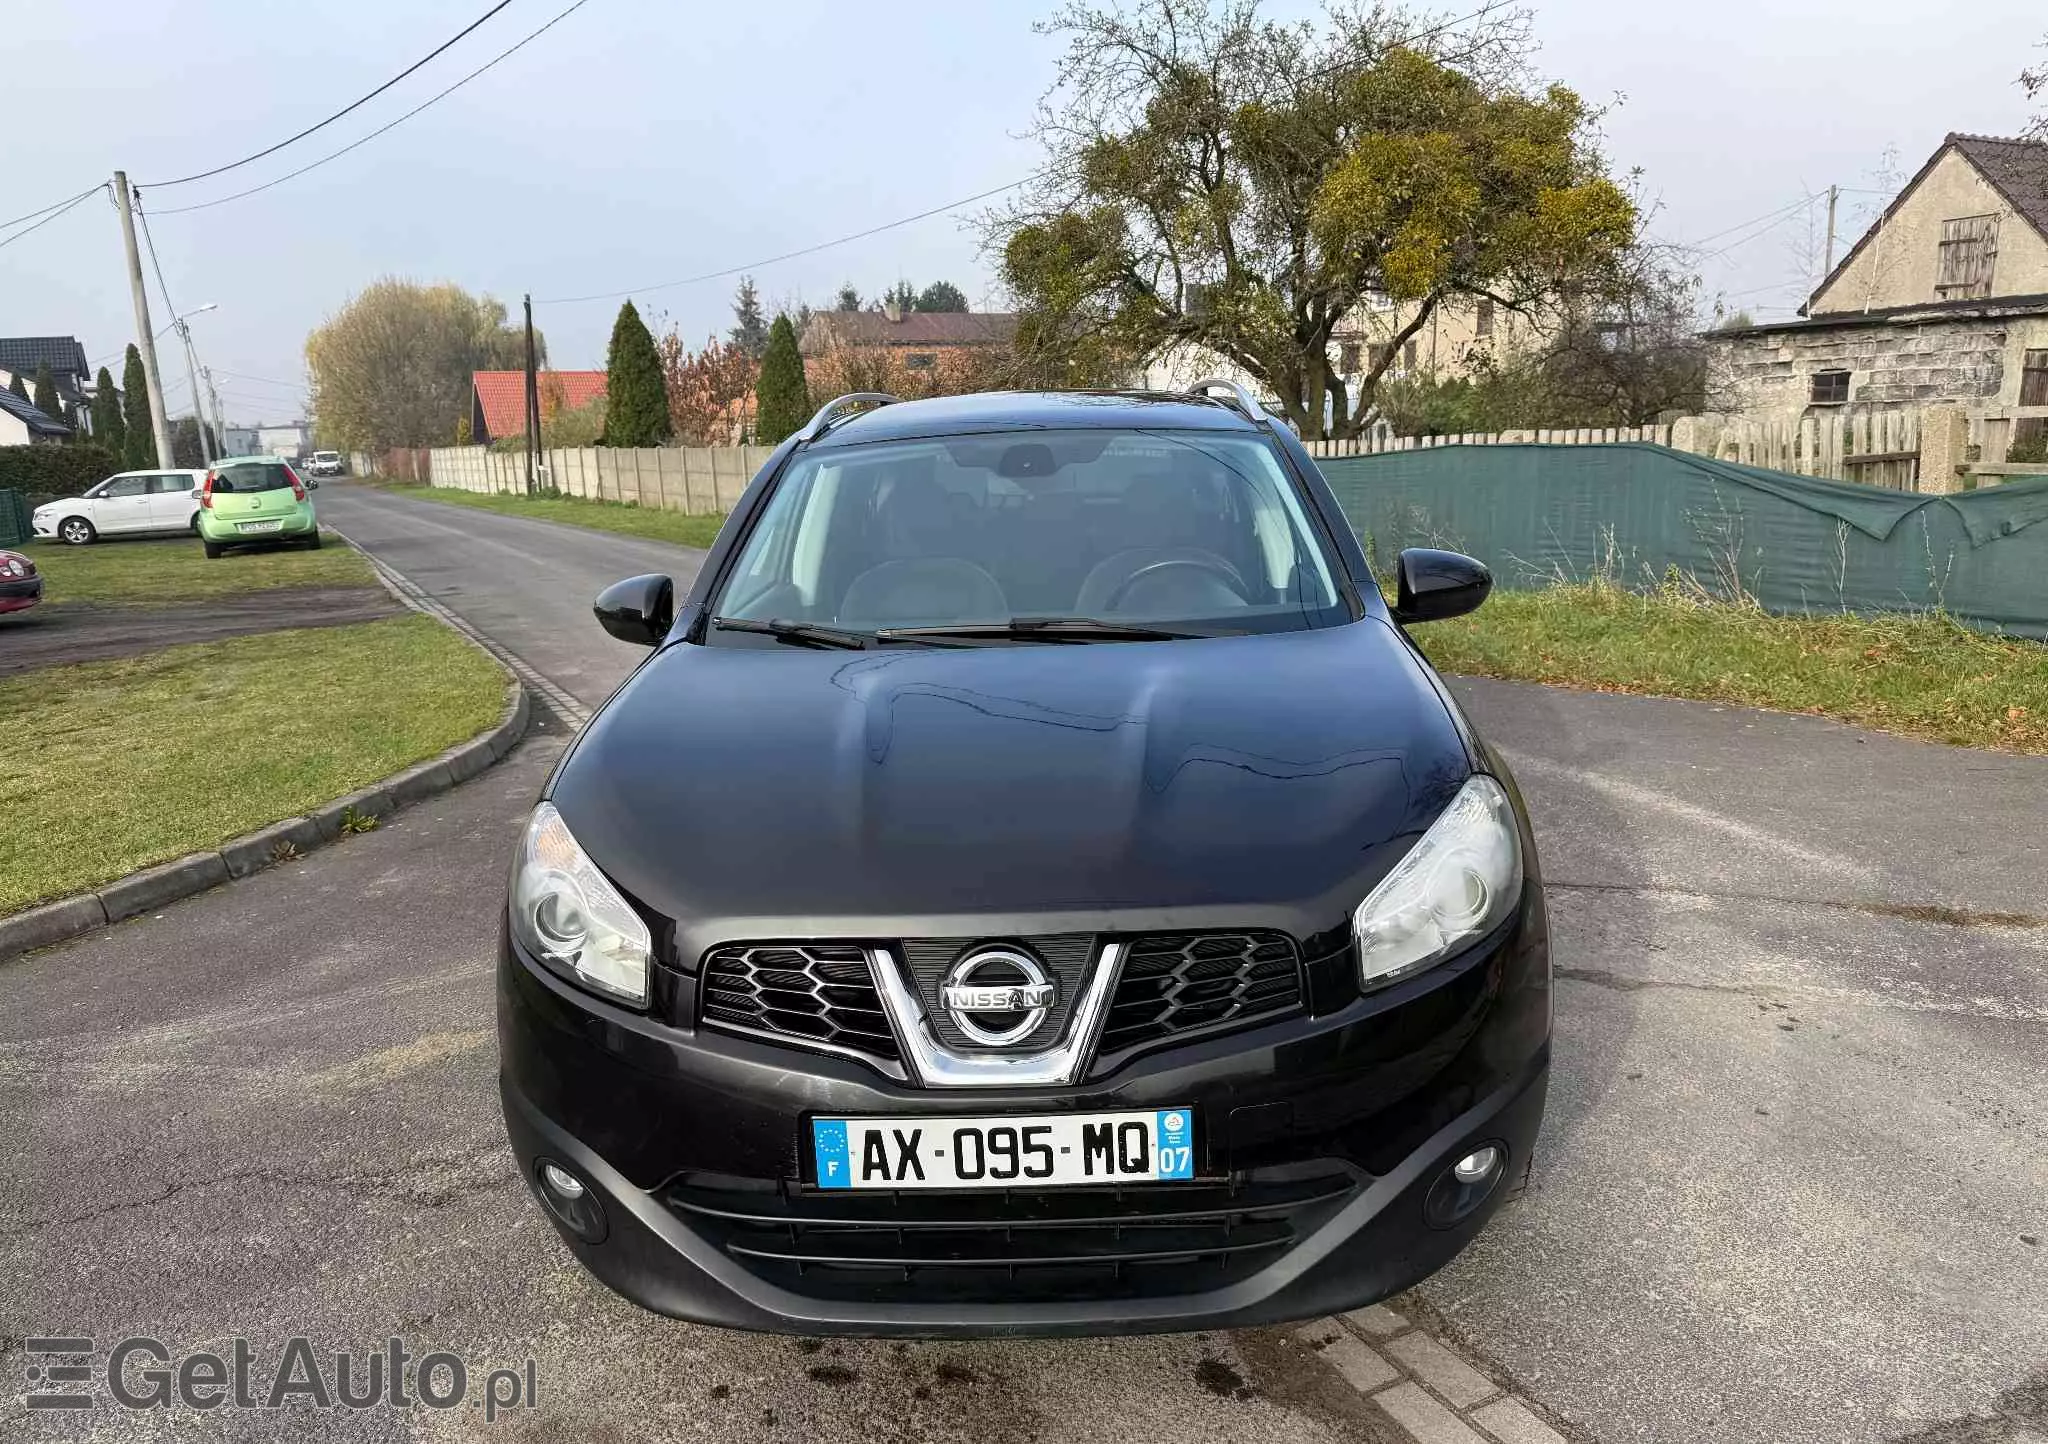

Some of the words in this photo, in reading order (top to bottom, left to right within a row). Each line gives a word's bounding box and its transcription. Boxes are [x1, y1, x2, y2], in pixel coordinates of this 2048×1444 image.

[952, 989, 1043, 1008] NISSAN
[827, 1160, 840, 1177] F
[1160, 1146, 1190, 1173] 07
